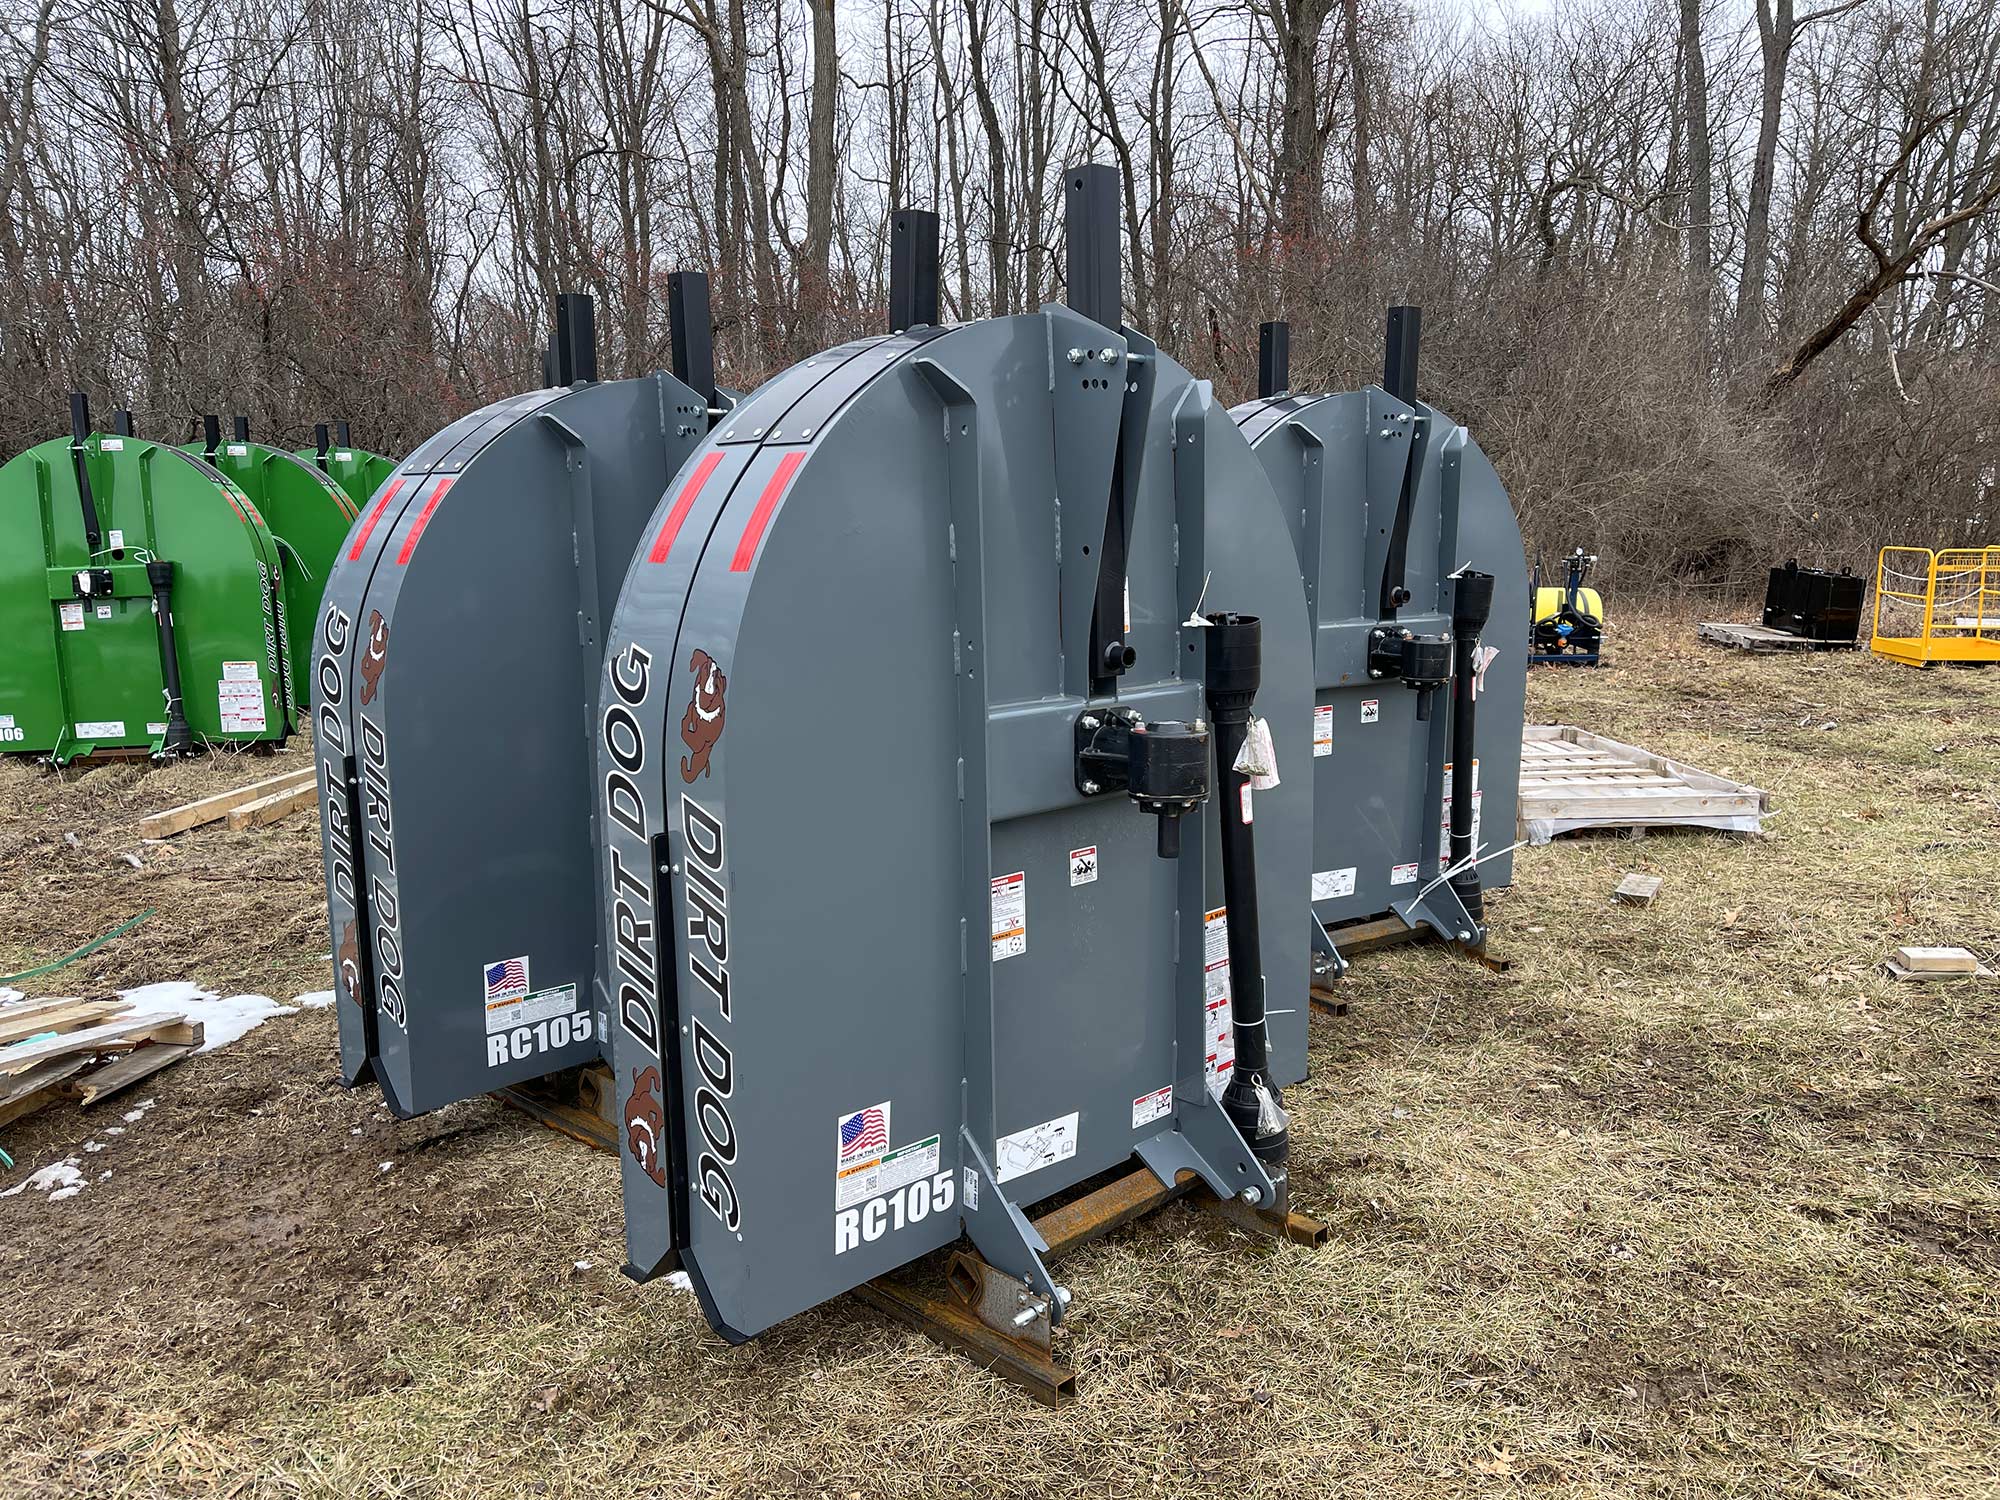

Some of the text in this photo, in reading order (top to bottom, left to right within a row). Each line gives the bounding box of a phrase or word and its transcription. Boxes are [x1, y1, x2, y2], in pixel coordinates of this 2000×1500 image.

[256, 559, 278, 673] DIRT DOG
[276, 600, 294, 710] DIRT DOG
[318, 606, 355, 909] DIRT DOG
[603, 642, 660, 1060] DIRT DOG
[360, 712, 407, 1028] DIRT DOG
[486, 1010, 592, 1068] RC105
[681, 792, 741, 1232] DIRT DOG
[834, 1168, 955, 1256] RC105
